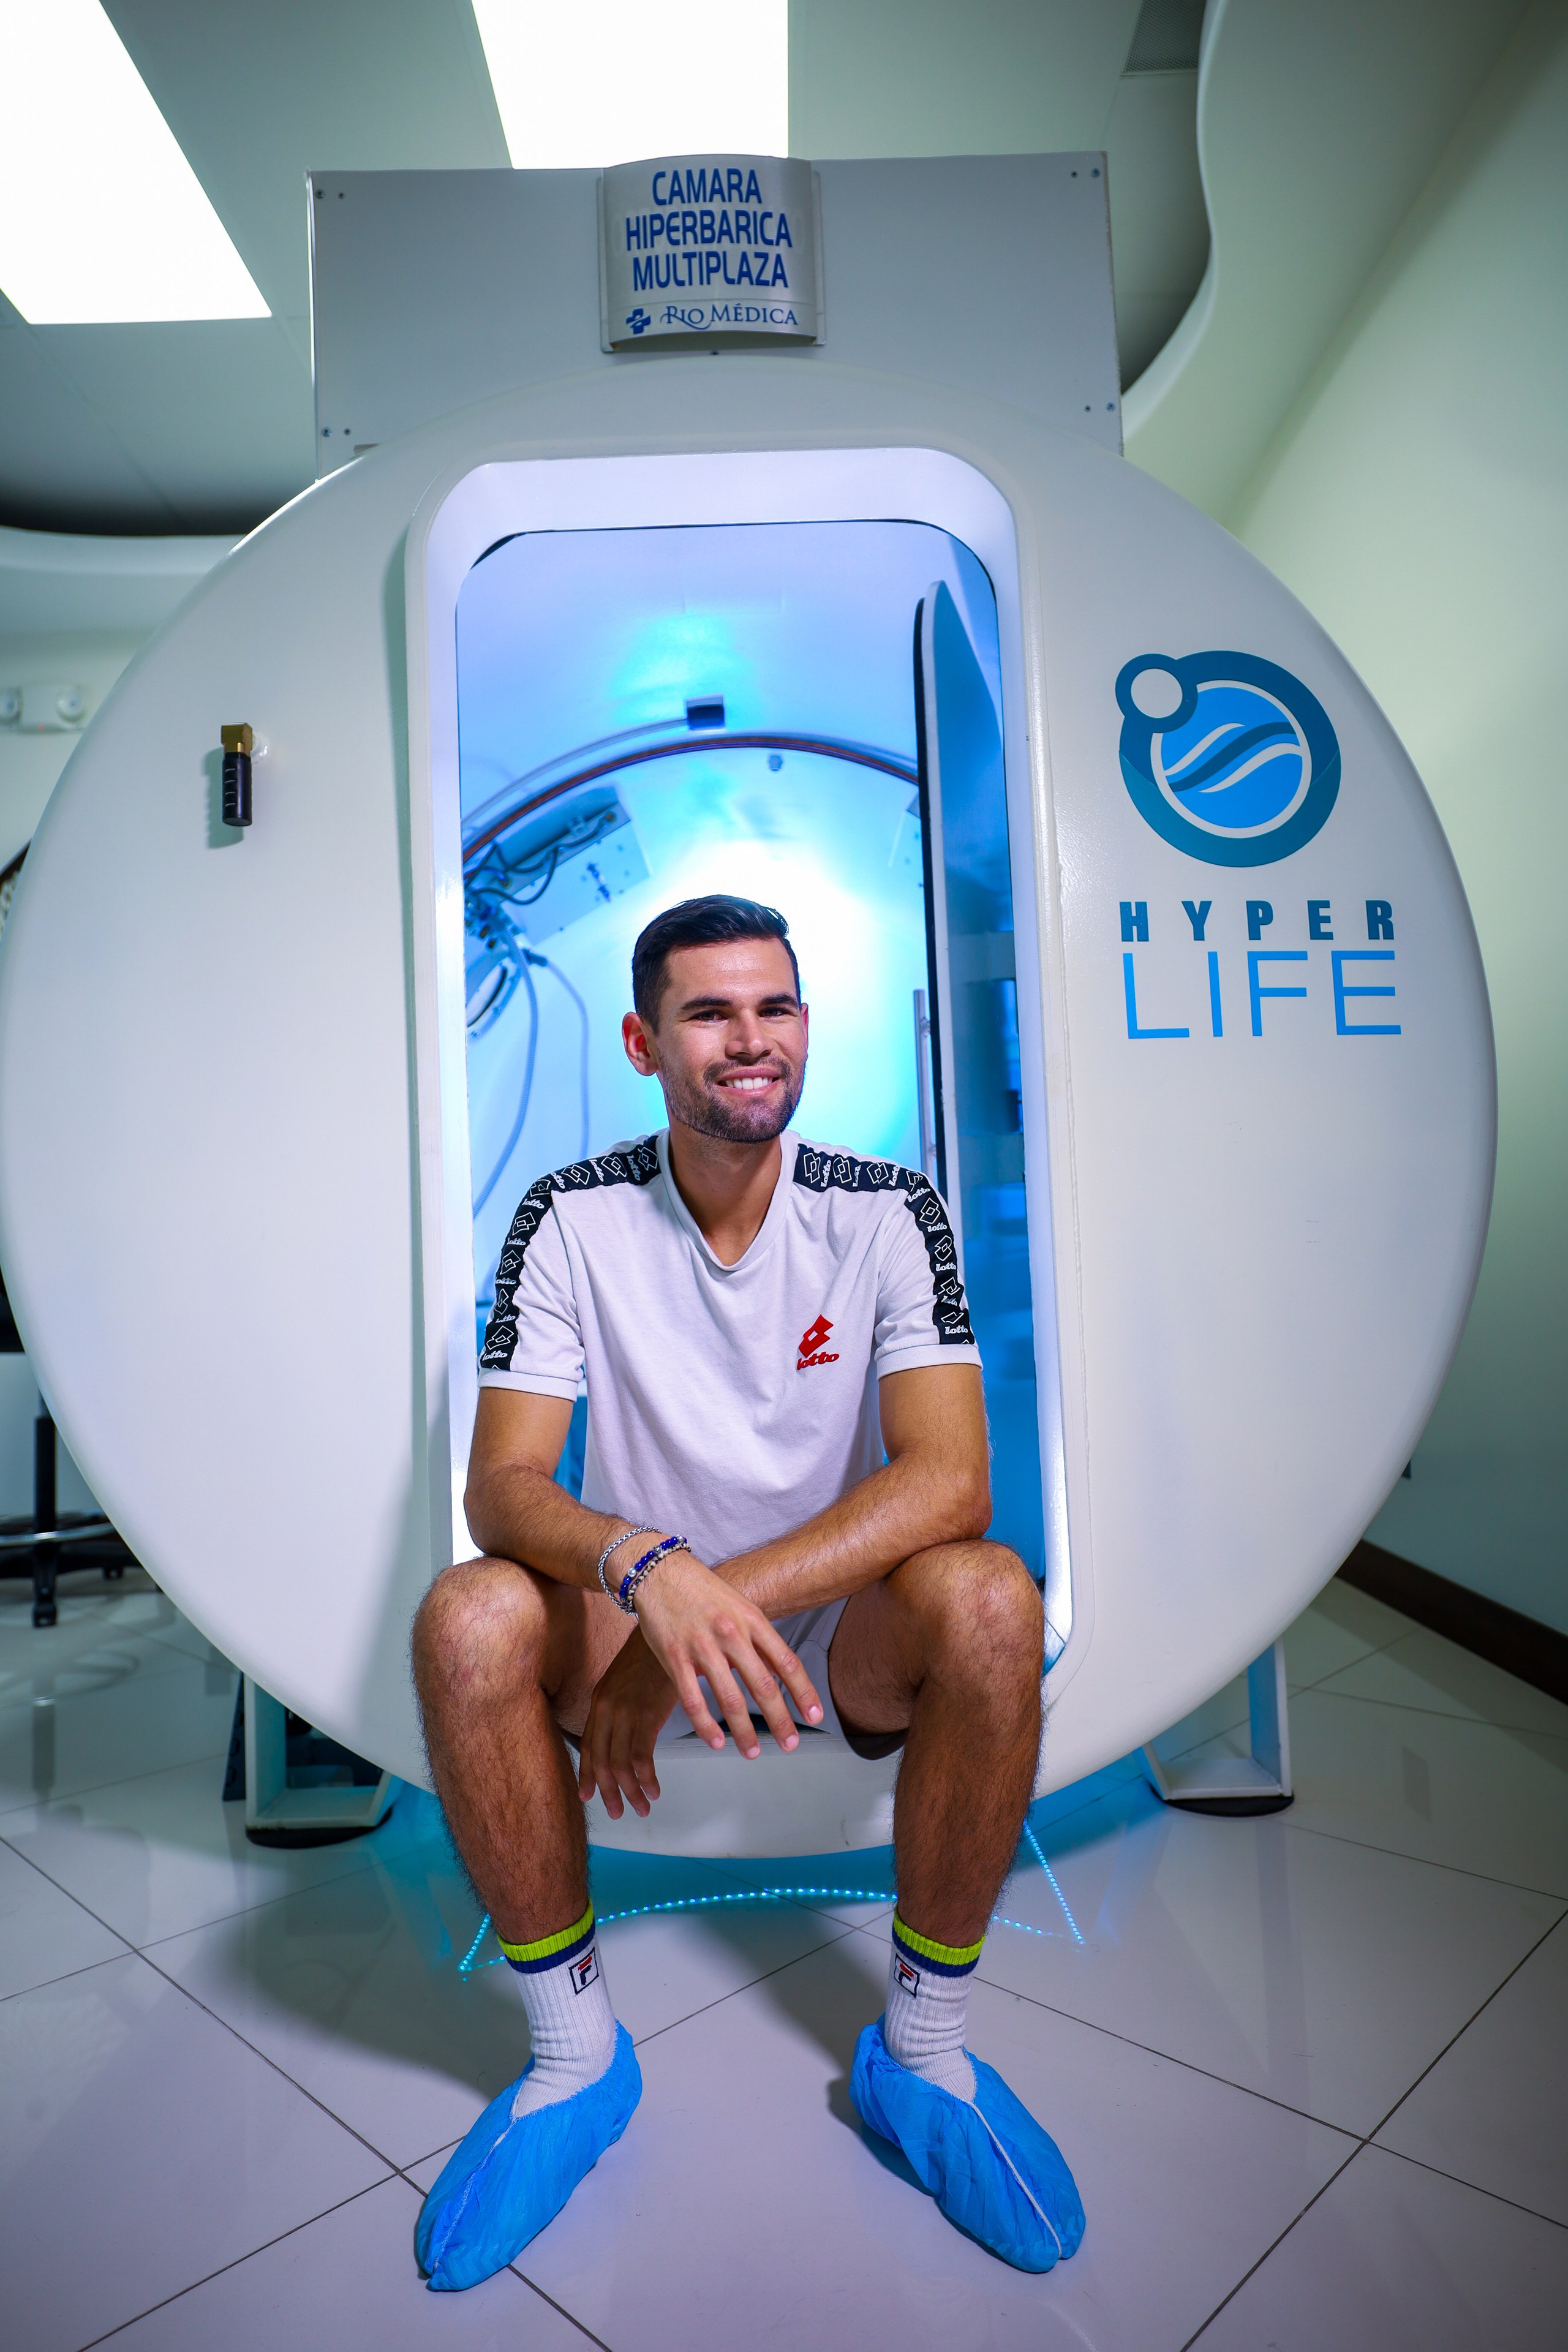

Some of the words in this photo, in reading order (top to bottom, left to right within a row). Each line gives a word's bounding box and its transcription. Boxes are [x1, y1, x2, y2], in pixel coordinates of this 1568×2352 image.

[652, 168, 762, 206] CAMARA
[626, 209, 793, 251] HIPERBARICA
[633, 251, 788, 291] MULTIPLAZA
[710, 303, 798, 325] MÉDICA
[1119, 900, 1395, 942] HYPER
[1123, 951, 1401, 1039] LIFE
[551, 1172, 565, 1189] otto
[797, 1351, 840, 1370] lotto
